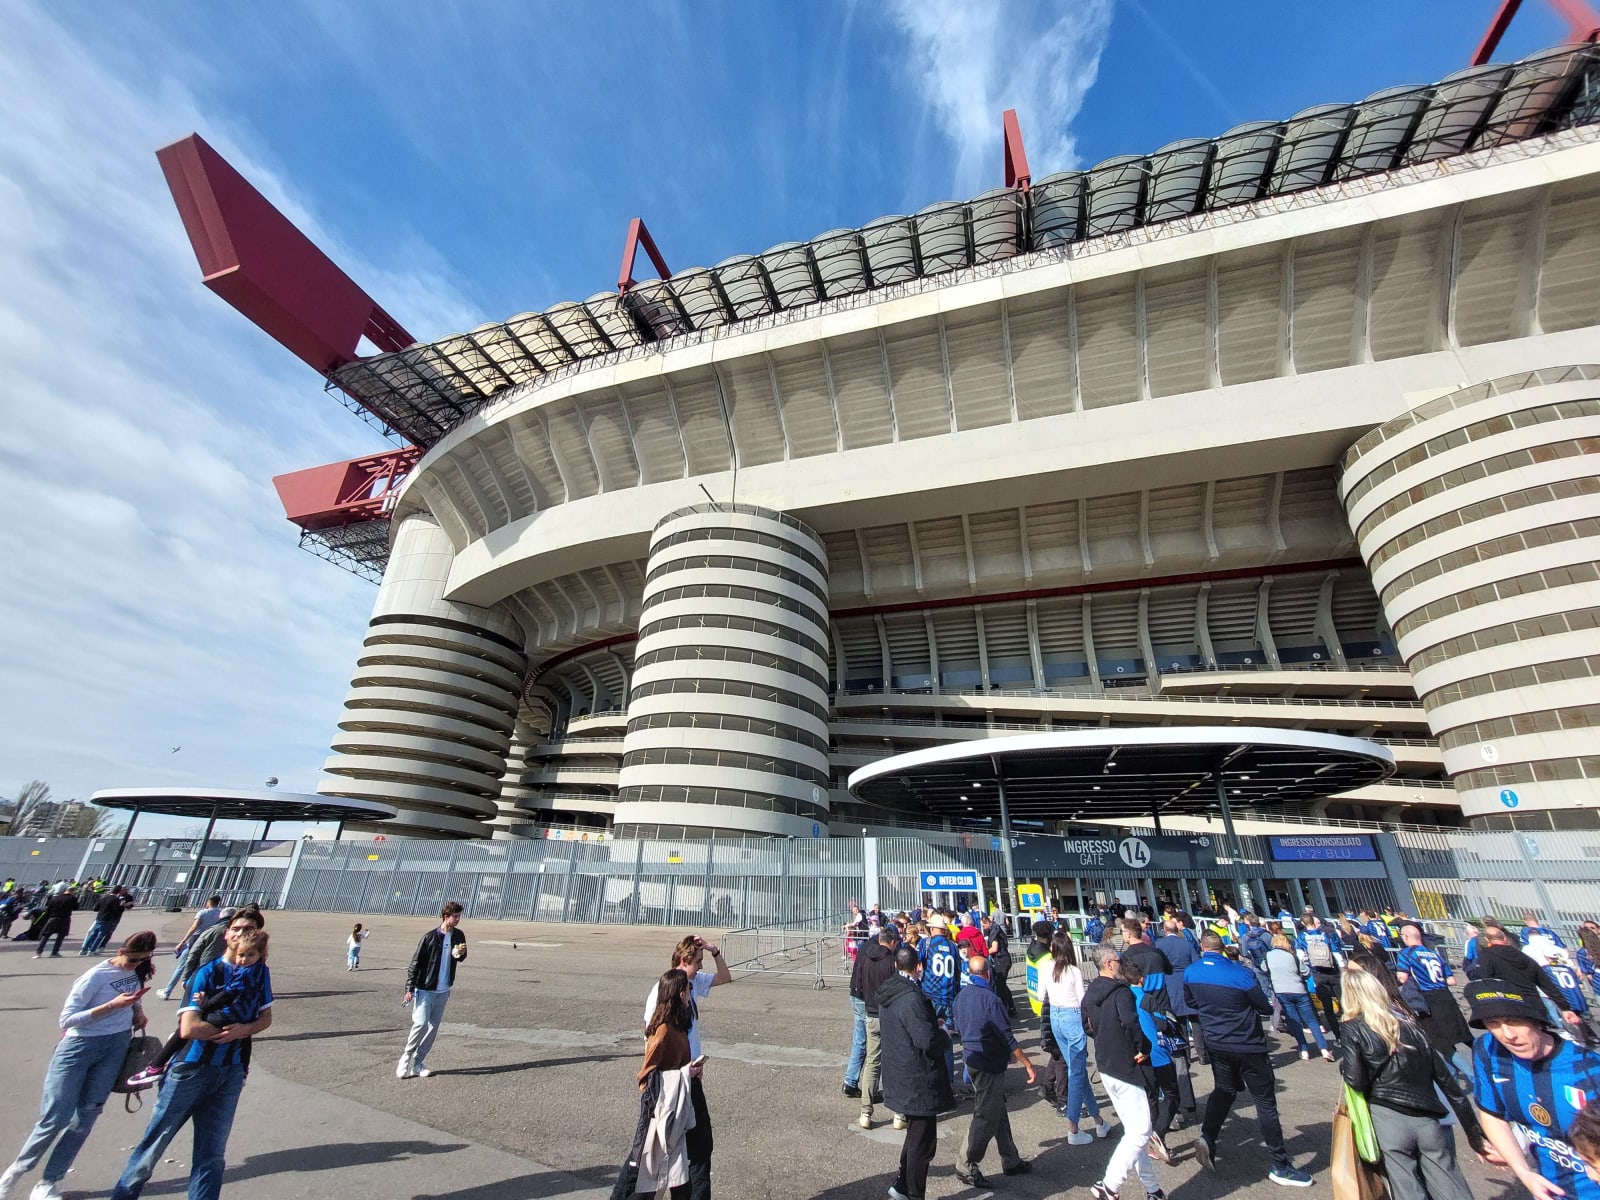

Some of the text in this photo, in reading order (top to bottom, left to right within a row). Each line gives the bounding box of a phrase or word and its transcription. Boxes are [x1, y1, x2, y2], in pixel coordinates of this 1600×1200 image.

[1064, 840, 1116, 854] INGRESSO
[1279, 837, 1362, 847] INGRESSO CONSIGLIATO
[1080, 853, 1105, 866] GATE
[1122, 841, 1147, 864] 14
[1326, 849, 1351, 859] BLU
[938, 876, 974, 886] INTER CLUB
[932, 952, 955, 979] 60
[1420, 958, 1445, 983] 16
[1551, 970, 1576, 989] 10
[1548, 1150, 1590, 1174] spo
